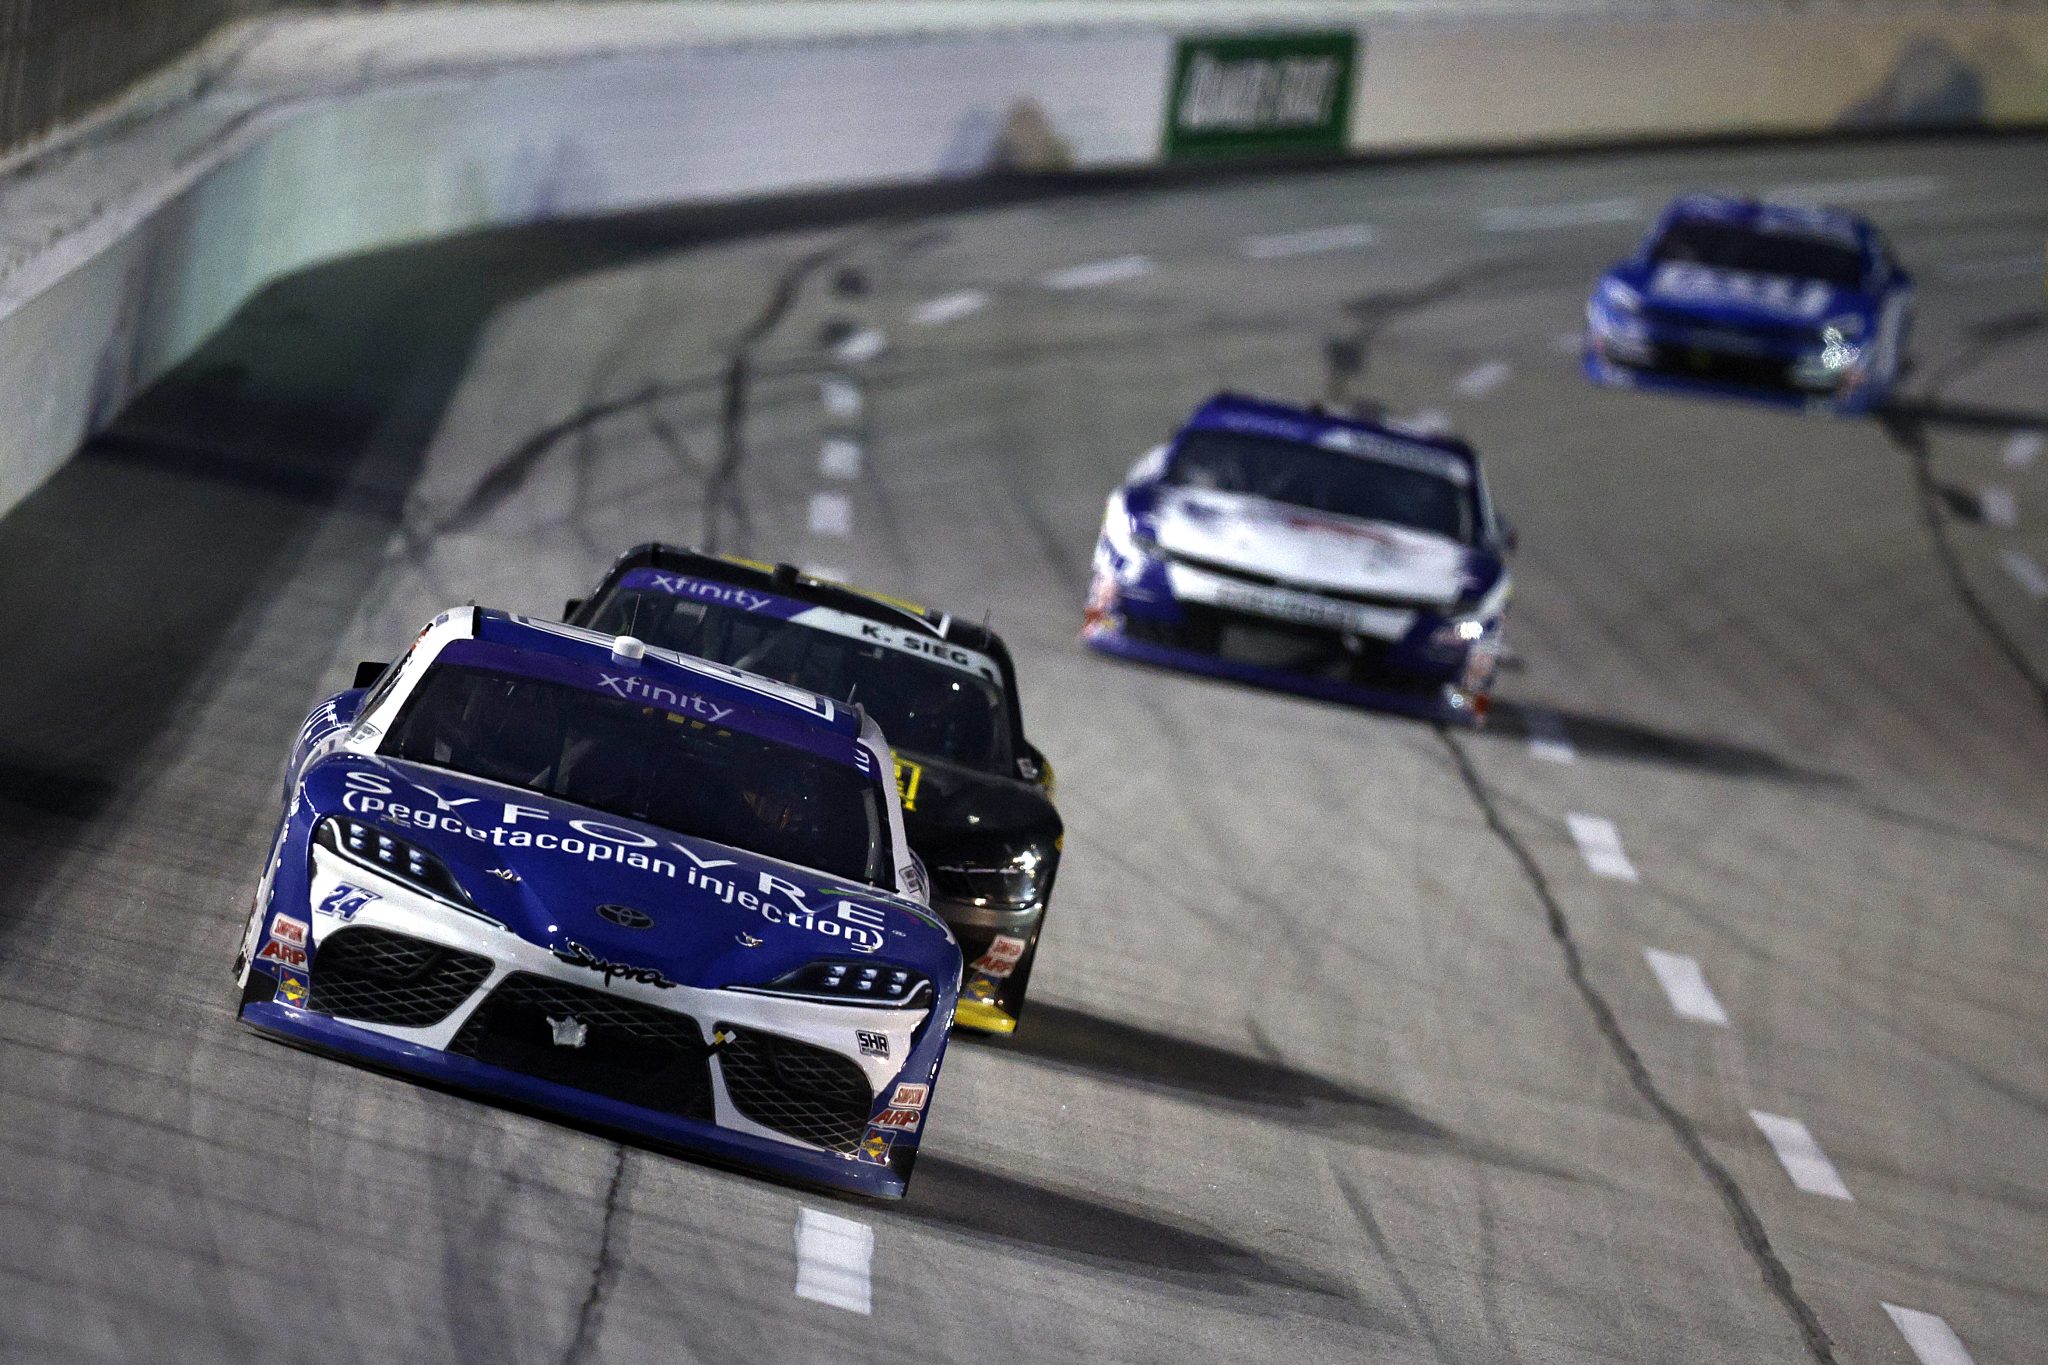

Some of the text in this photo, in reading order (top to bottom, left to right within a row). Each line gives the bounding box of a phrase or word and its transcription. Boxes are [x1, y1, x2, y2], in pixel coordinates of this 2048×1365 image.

[652, 574, 771, 611] xfinity
[861, 624, 969, 667] K. SIEG
[597, 672, 734, 722] xfinity
[345, 771, 886, 931] SYFOVRE
[317, 881, 381, 922] 24
[261, 941, 306, 966] ARP
[552, 941, 677, 989] Supra
[858, 1032, 889, 1052] SHR
[874, 1109, 920, 1127] ARP
